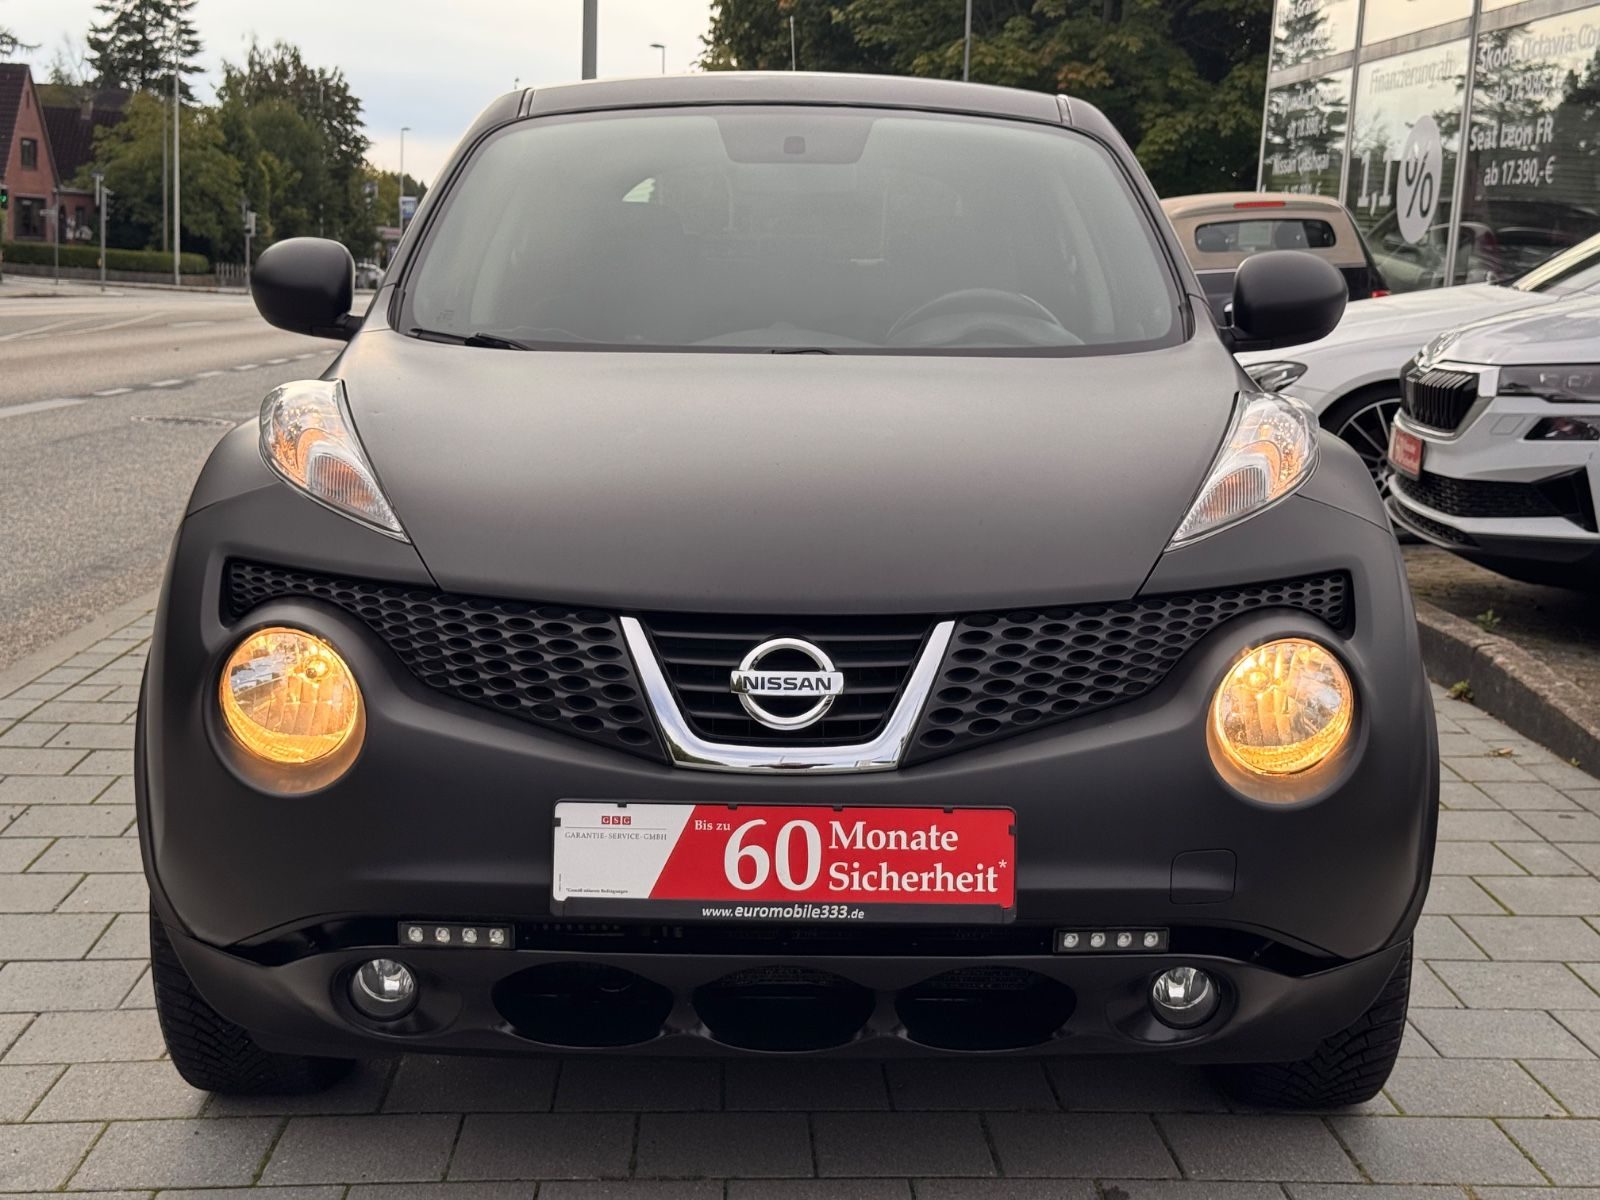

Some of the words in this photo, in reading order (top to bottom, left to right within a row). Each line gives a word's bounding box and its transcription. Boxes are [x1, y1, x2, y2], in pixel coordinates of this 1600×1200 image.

[1522, 27, 1575, 60] Octavia
[1469, 120, 1498, 152] Seat
[1500, 124, 1534, 148] Leon
[1535, 114, 1554, 144] FR
[1483, 160, 1499, 187] ab
[743, 675, 832, 691] NISSAN
[694, 820, 714, 831] Bis
[716, 822, 731, 831] zu
[828, 820, 959, 851] Monate
[724, 819, 823, 892] 60
[702, 904, 865, 919] www.euromobile333.de
